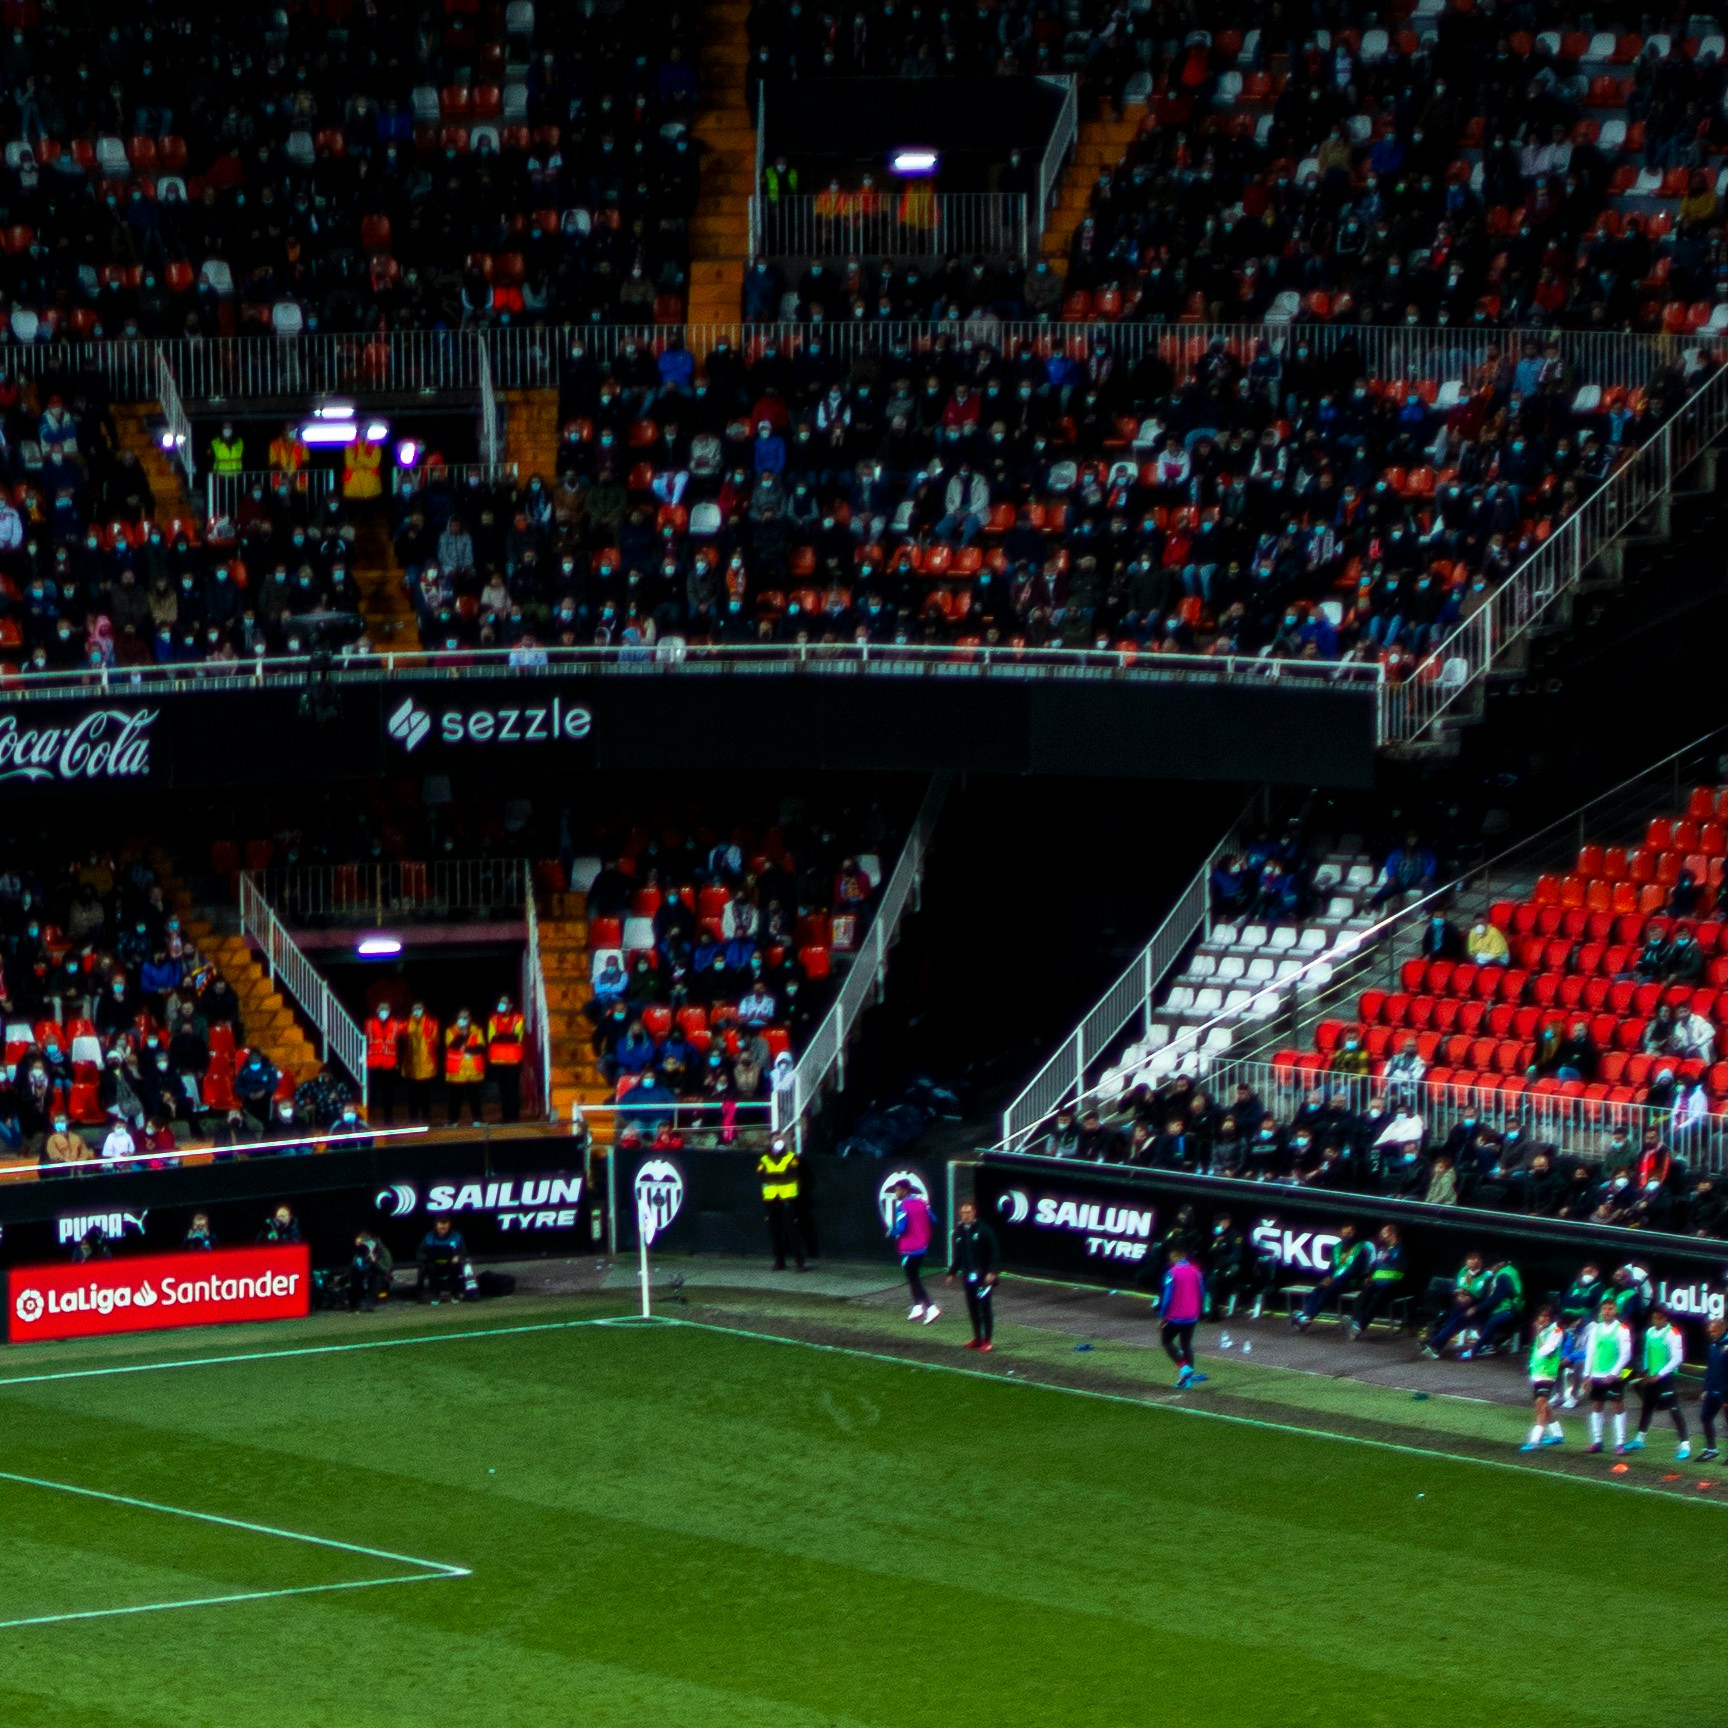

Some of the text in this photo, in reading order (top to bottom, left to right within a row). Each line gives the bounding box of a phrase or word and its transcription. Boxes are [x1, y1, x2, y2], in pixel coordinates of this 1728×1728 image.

[442, 697, 592, 742] sezzle
[426, 1177, 583, 1211] SAILUN
[59, 1213, 124, 1244] PUMA
[497, 1209, 578, 1231] TYRE
[1035, 1198, 1153, 1237] SAILUN
[1087, 1236, 1148, 1261] TYRE
[1252, 1218, 1344, 1271] ŠKO
[48, 1270, 300, 1314] LaLiga Santander
